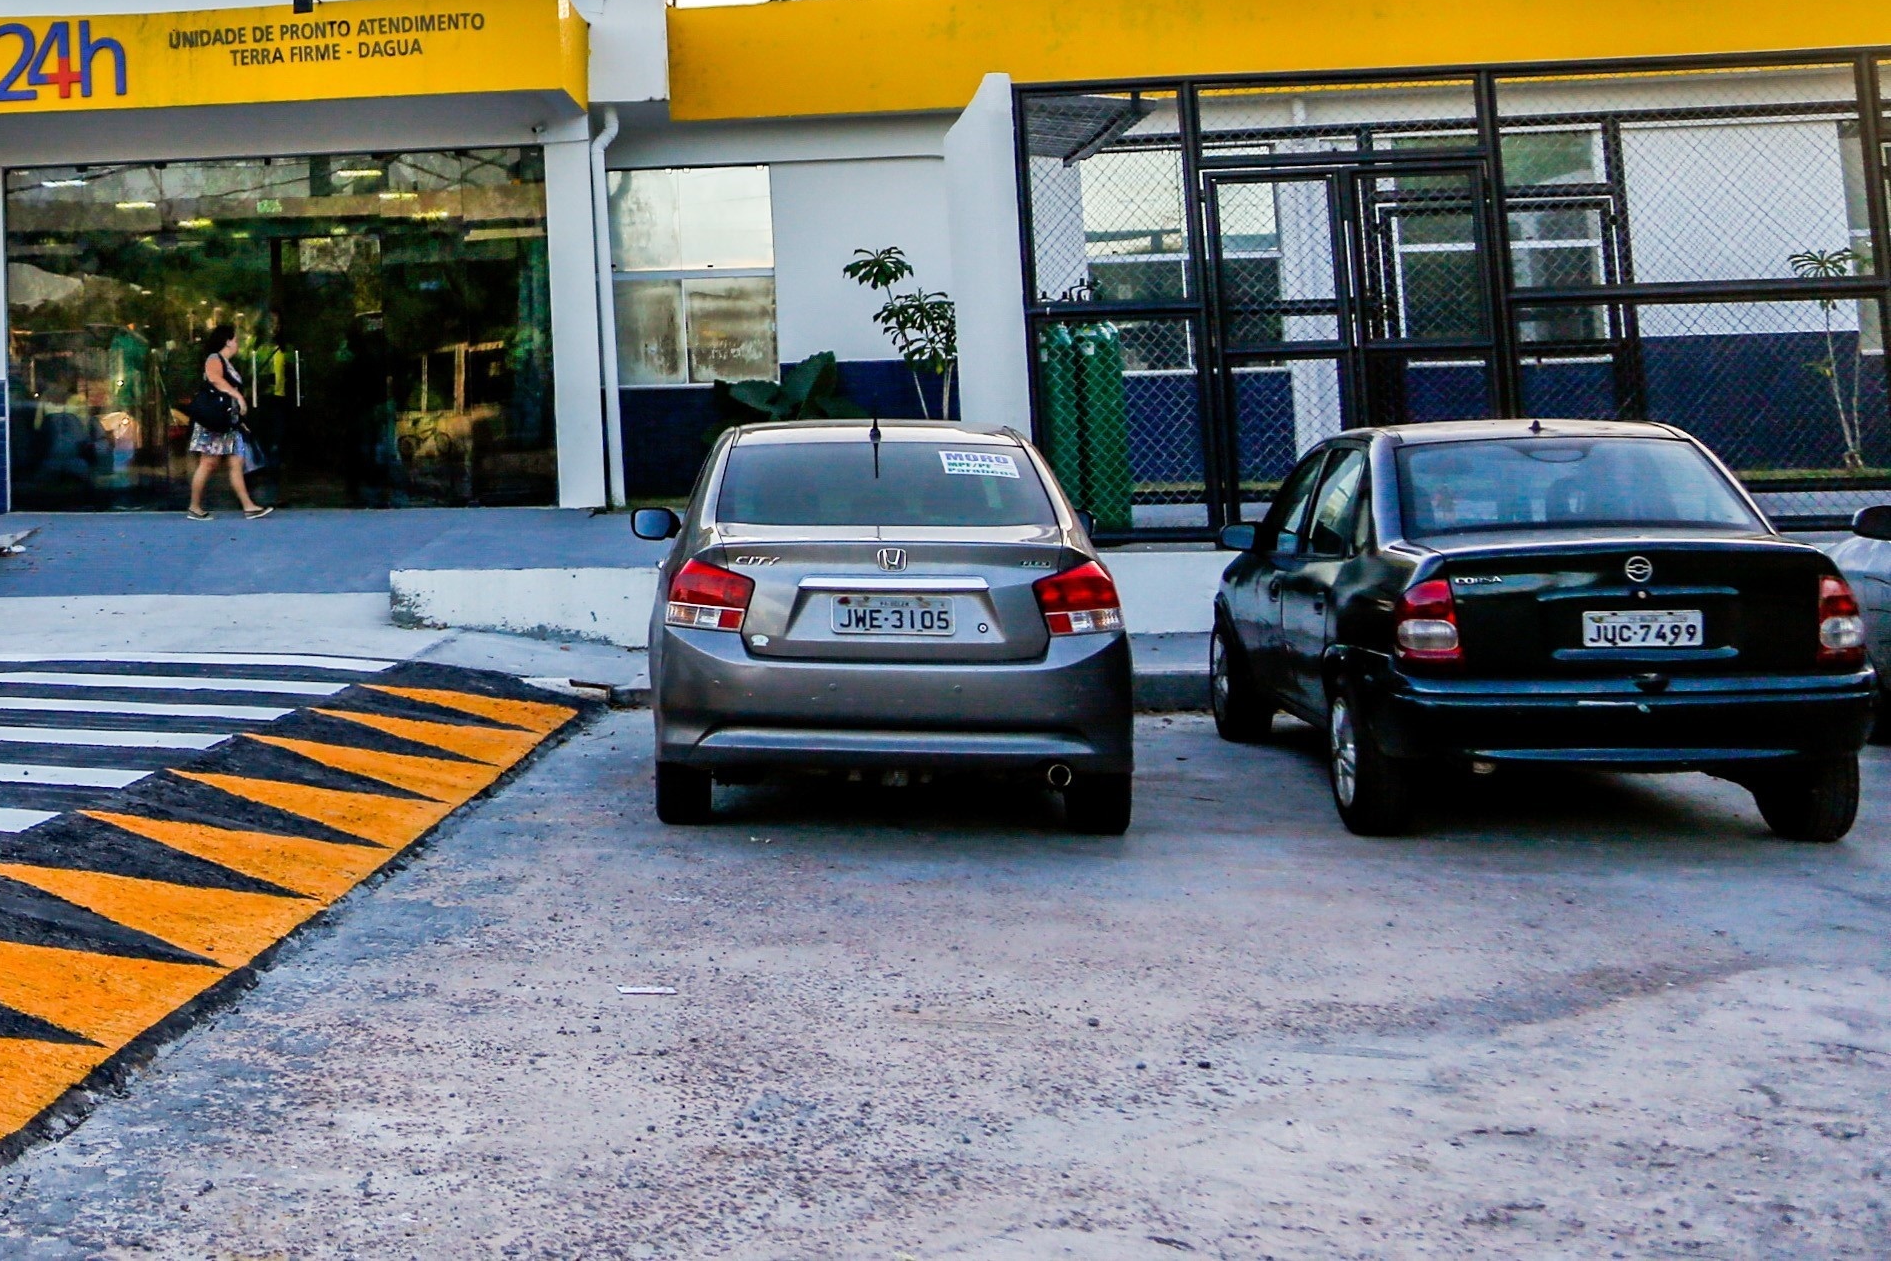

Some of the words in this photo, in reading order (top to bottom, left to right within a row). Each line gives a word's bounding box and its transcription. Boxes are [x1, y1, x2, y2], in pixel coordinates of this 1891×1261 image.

[168, 27, 247, 49] UNIDADE
[252, 25, 275, 43] DE
[279, 20, 351, 41] PRONTO
[356, 12, 486, 37] ATENDIMENTO
[229, 46, 285, 67] TERRA
[289, 43, 341, 63] FIRME
[358, 38, 424, 59] DAGUA
[945, 453, 1009, 464] MORO
[735, 556, 781, 566] CITY
[1454, 575, 1503, 585] CORSA
